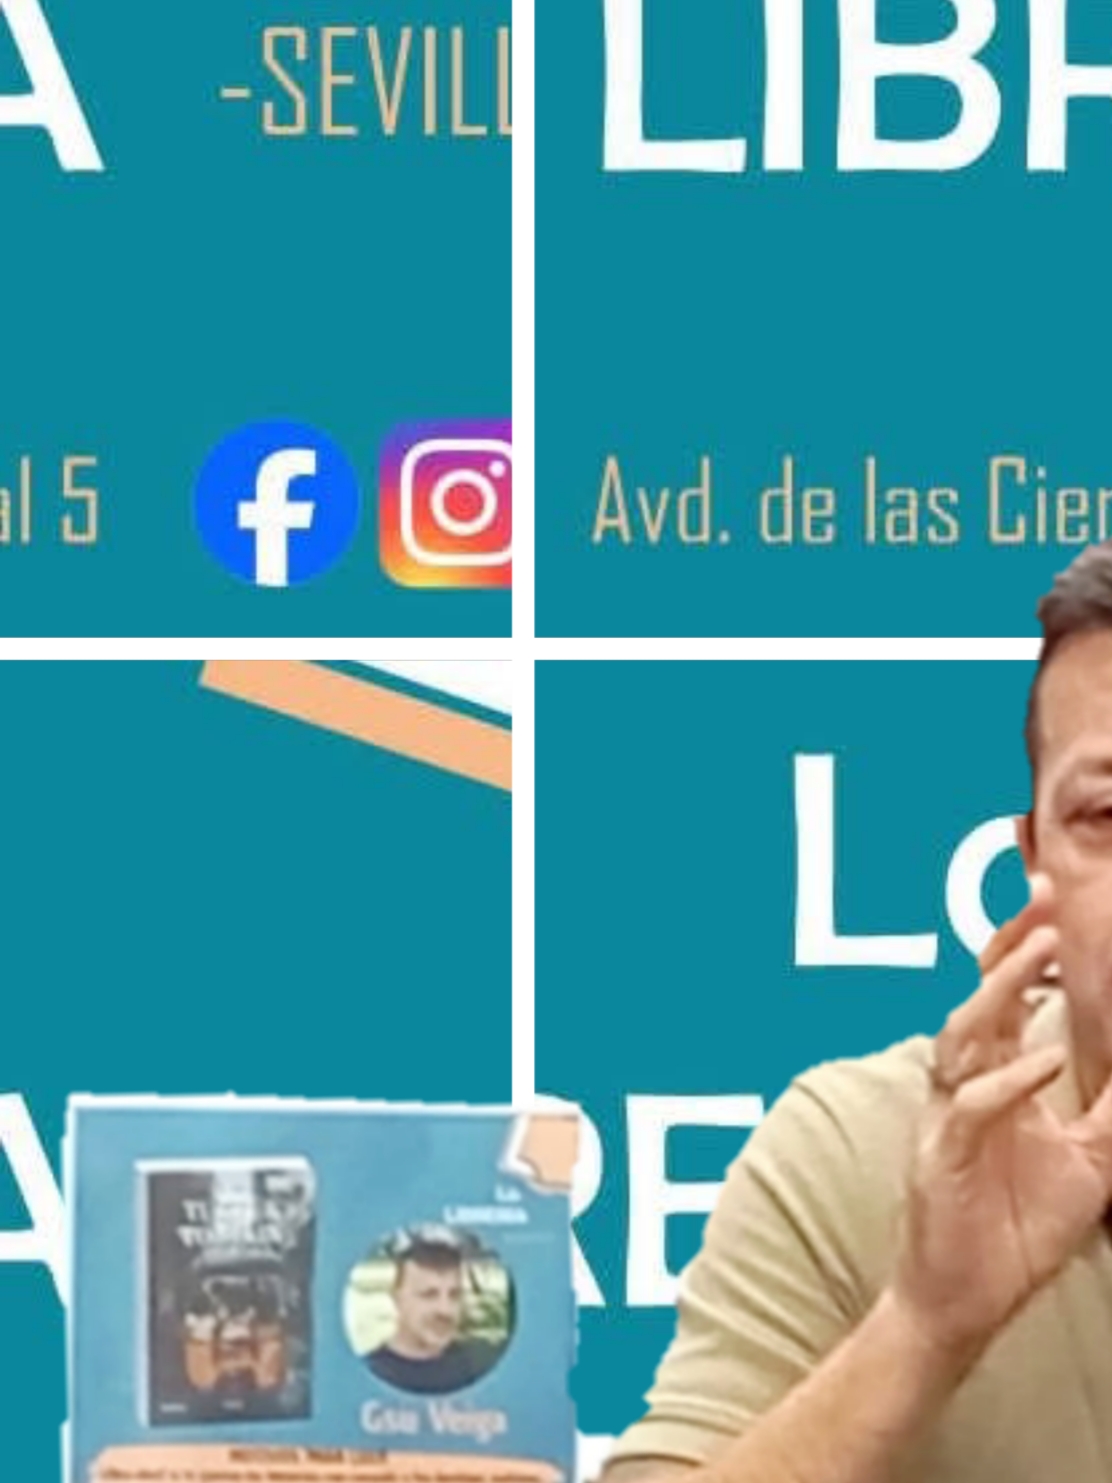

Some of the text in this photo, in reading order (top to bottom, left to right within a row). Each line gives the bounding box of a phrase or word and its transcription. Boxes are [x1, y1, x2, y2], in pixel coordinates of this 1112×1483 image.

[62, 456, 98, 543] 5
[591, 455, 731, 545] Avd.
[760, 455, 836, 545] de
[866, 455, 960, 545] las
